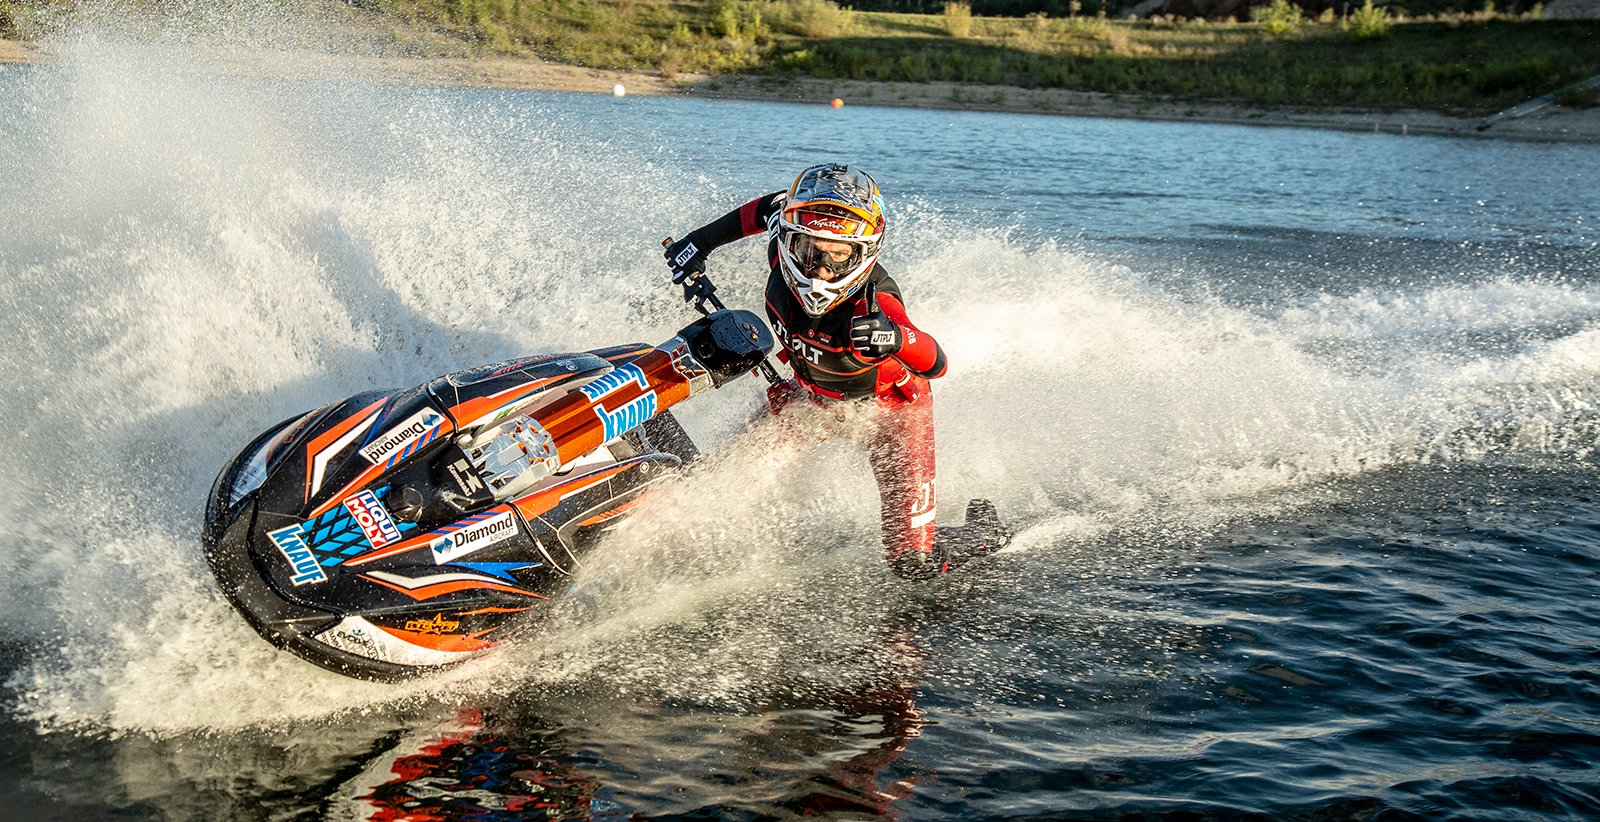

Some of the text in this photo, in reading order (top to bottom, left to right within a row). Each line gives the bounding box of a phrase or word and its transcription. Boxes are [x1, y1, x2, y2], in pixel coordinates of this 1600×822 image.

[678, 245, 696, 265] JTPLT
[873, 333, 893, 344] JTPLT
[596, 392, 656, 443] KNAUF
[368, 421, 426, 463] Diamond
[447, 464, 472, 496] Kawasaki
[348, 499, 387, 546] MOLY
[359, 492, 397, 541] LIQUI
[454, 513, 513, 548] Diamond
[489, 527, 515, 543] AIRCRAFT
[270, 525, 325, 584] KNAUF
